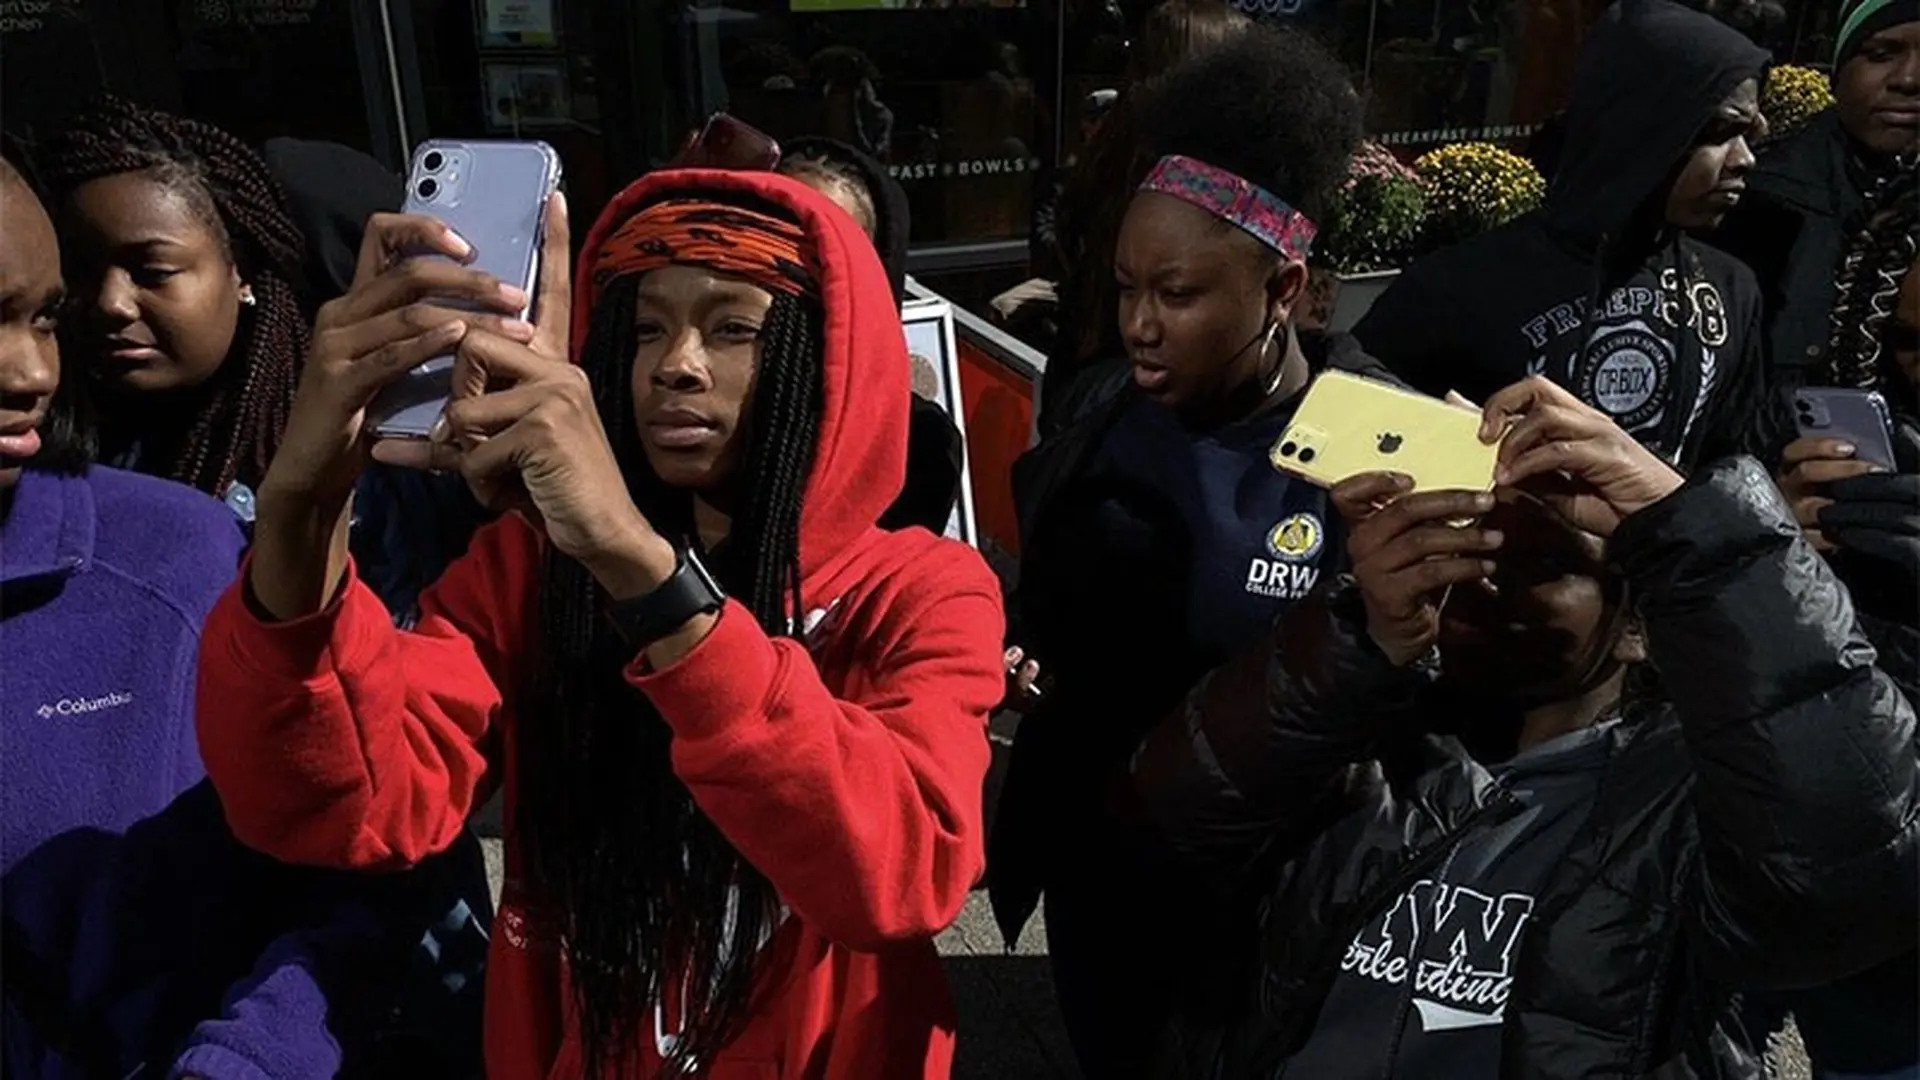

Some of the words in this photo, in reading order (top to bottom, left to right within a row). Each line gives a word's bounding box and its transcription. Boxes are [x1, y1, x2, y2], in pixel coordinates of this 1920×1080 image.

[1380, 126, 1468, 145] BREAKFAST
[957, 157, 1026, 177] BOWLS
[1247, 557, 1320, 590] DRW
[1244, 581, 1288, 599] COLLEGE
